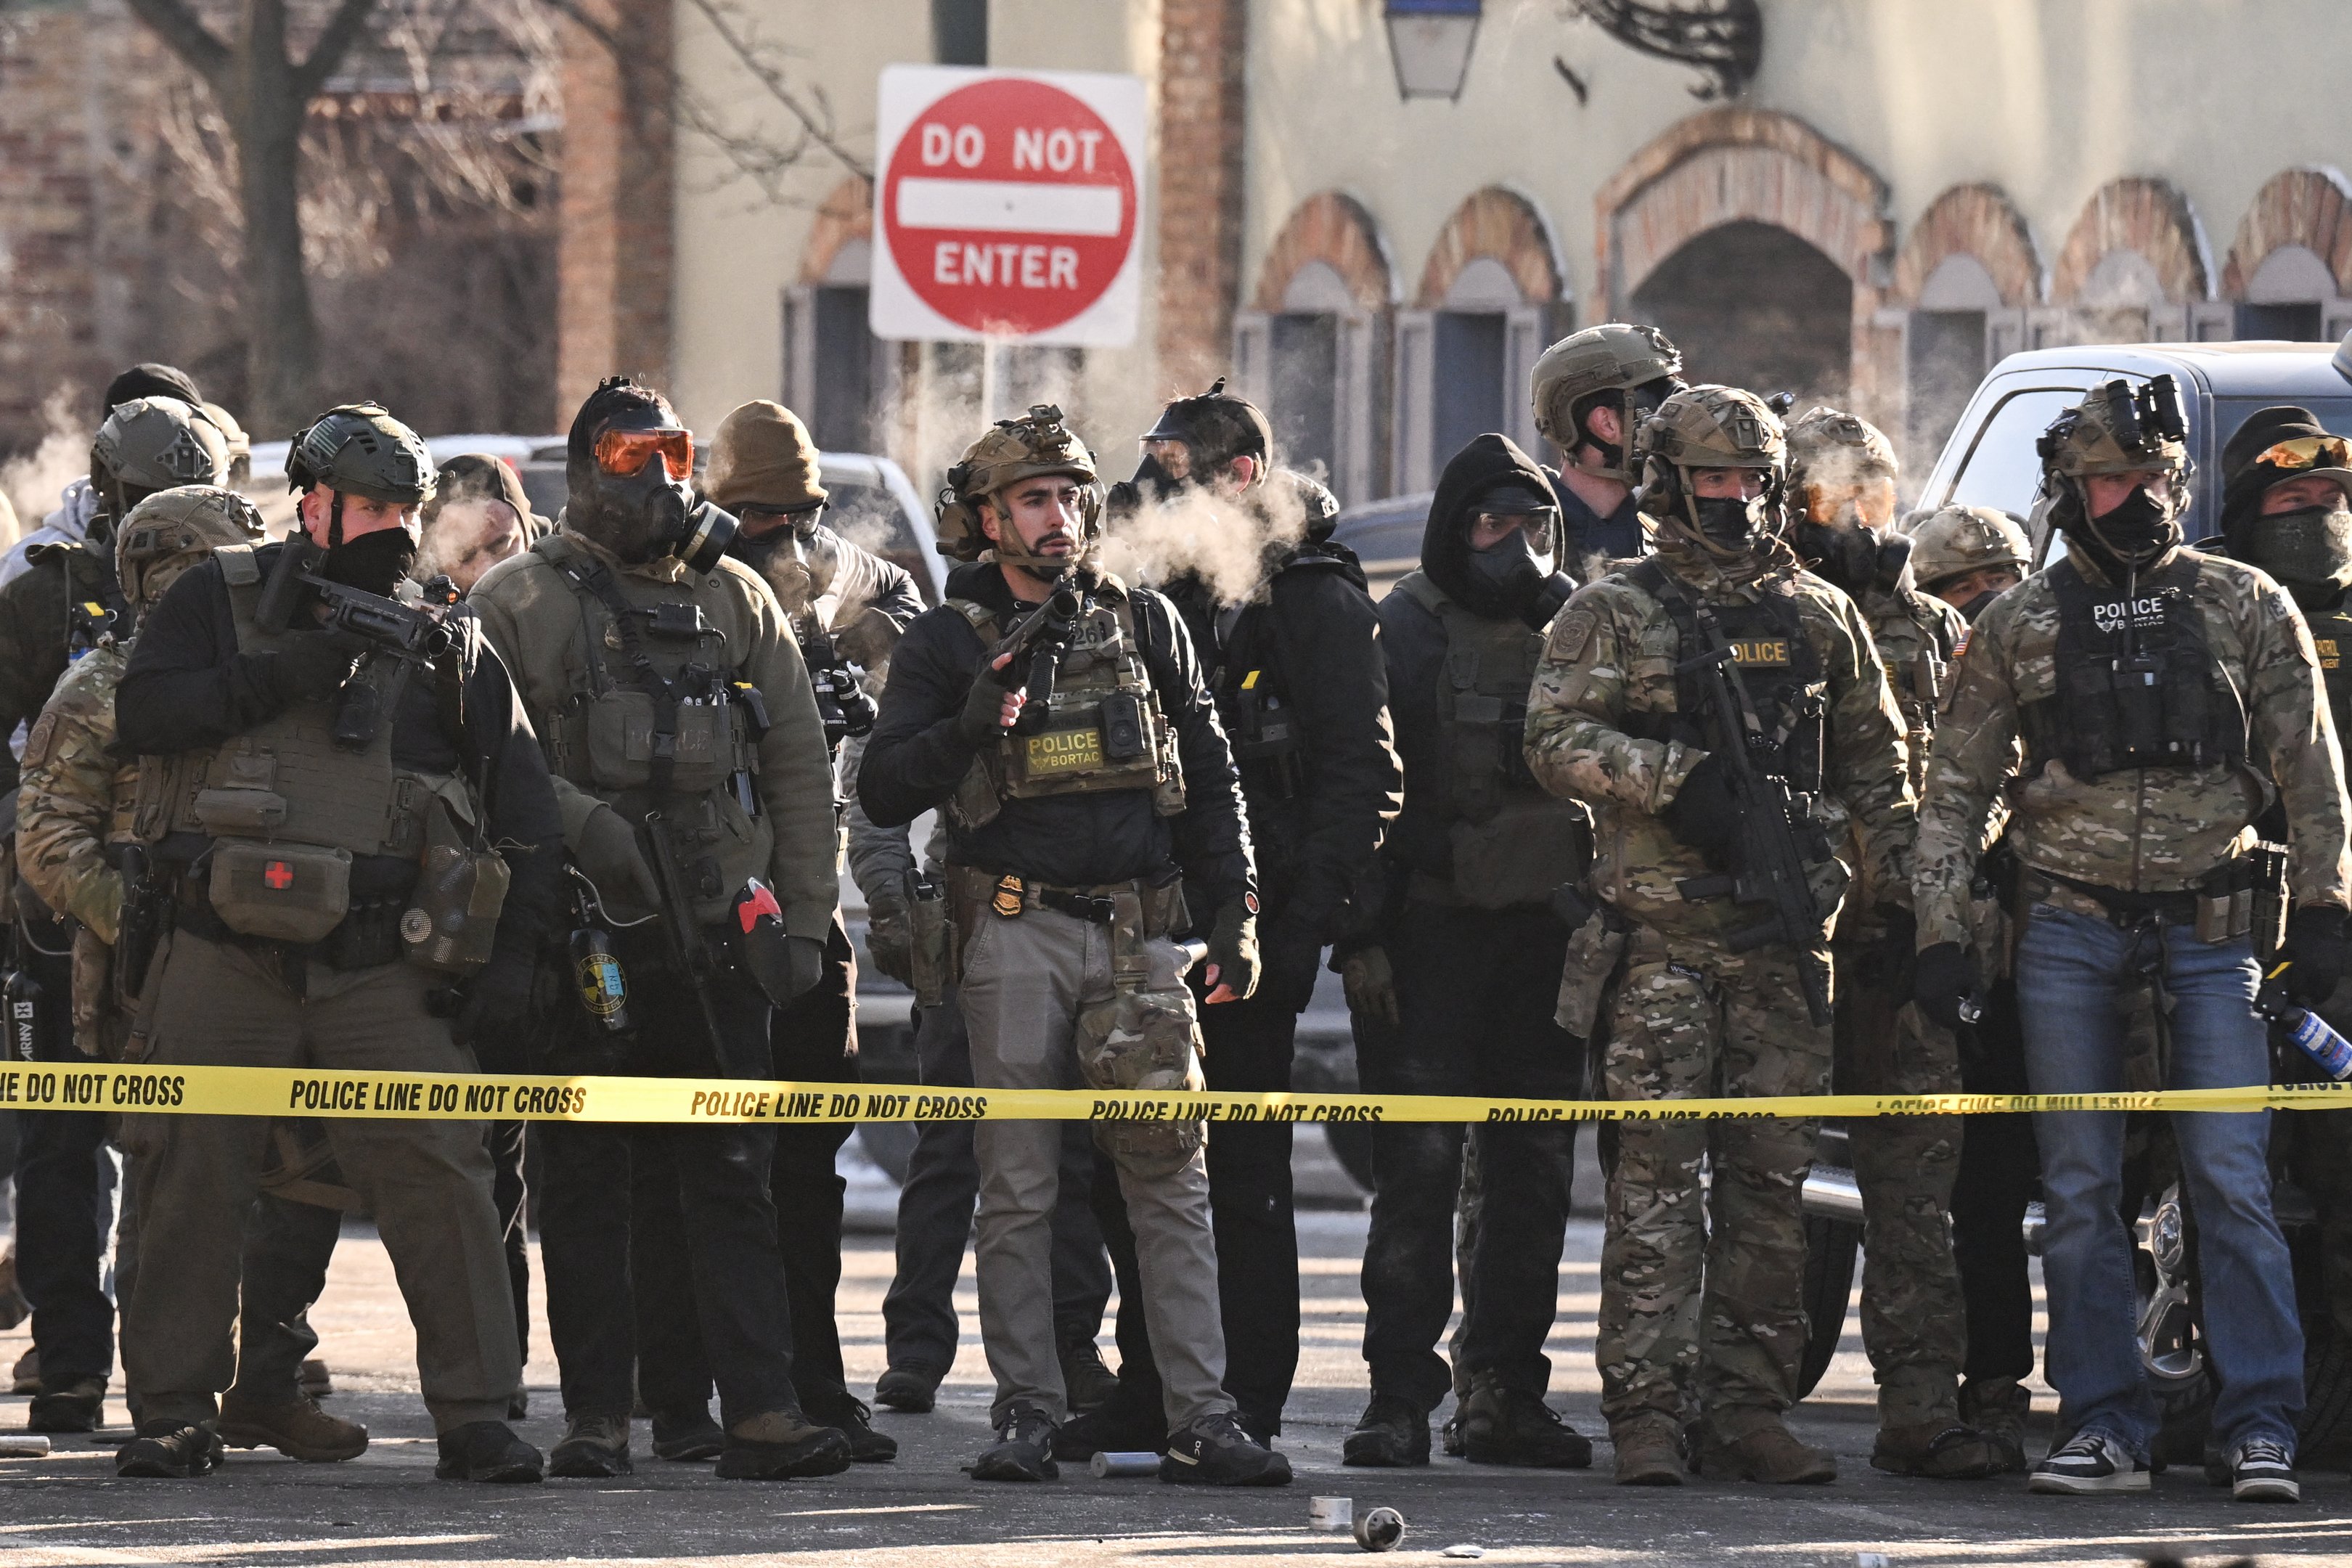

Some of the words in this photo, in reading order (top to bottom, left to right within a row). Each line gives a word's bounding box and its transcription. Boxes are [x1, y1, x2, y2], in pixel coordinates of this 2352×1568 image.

[920, 123, 985, 168] DO
[1013, 126, 1103, 174] NOT
[934, 241, 1079, 289] ENTER
[1731, 642, 1786, 662] OLICE
[1029, 731, 1098, 754] POLICE
[1050, 751, 1099, 767] BORTAC
[18, 1021, 33, 1061] ARMY
[26, 1073, 56, 1103] DO
[63, 1074, 107, 1104] NOT
[113, 1075, 185, 1106] CROSS
[290, 1079, 369, 1110] POLICE
[374, 1082, 423, 1111] LINE
[428, 1084, 459, 1112] DO
[465, 1085, 510, 1113] NOT
[514, 1086, 587, 1114] CROSS
[690, 1091, 769, 1117] POLICE
[774, 1093, 824, 1118] LINE
[828, 1094, 860, 1118] DO
[865, 1095, 910, 1119] NOT
[915, 1095, 987, 1119] CROSS
[1090, 1100, 1168, 1120] POLICE
[1172, 1102, 1222, 1121] LINE
[1264, 1104, 1307, 1122] NOT
